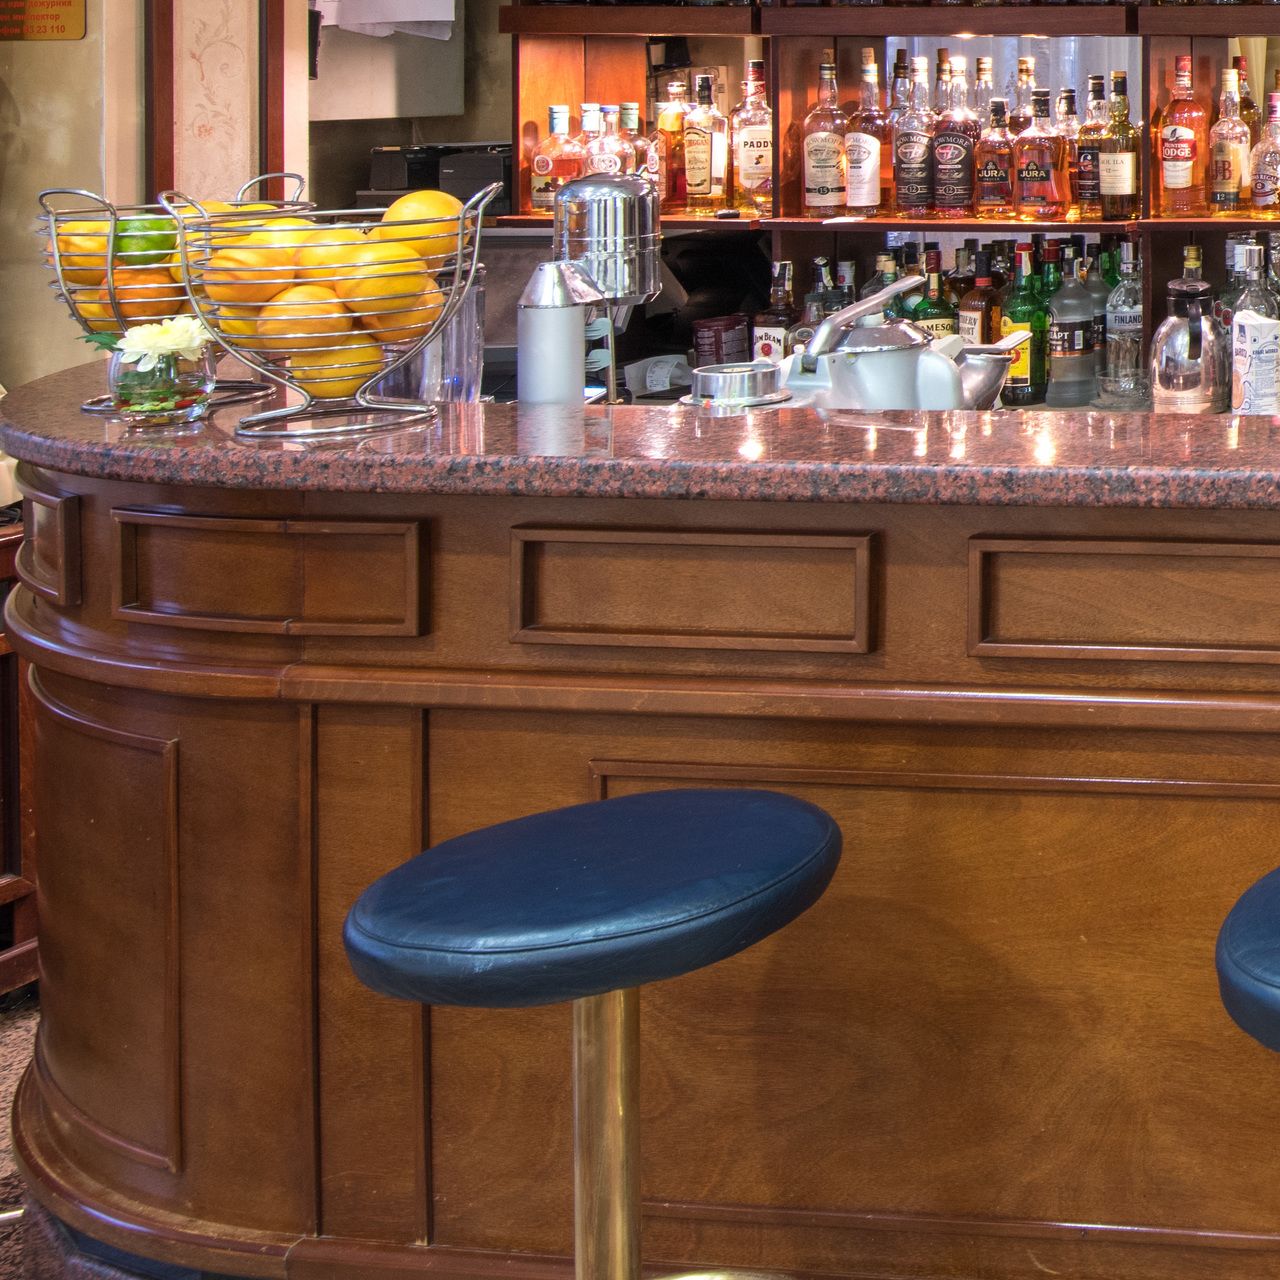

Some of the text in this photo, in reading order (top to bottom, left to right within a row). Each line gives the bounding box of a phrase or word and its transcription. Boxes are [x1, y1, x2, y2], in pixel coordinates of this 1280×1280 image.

[50, 24, 66, 33] 110
[743, 140, 774, 149] PADDY
[897, 136, 931, 147] BOWMORE
[934, 136, 969, 148] BOWMORE
[978, 169, 1006, 178] JURA
[1020, 169, 1046, 178] JURA
[909, 185, 918, 193] 12
[946, 186, 955, 194] 12
[1216, 193, 1226, 201] 12
[1114, 315, 1143, 325] FINLAND
[753, 331, 782, 347] JIM BEAM
